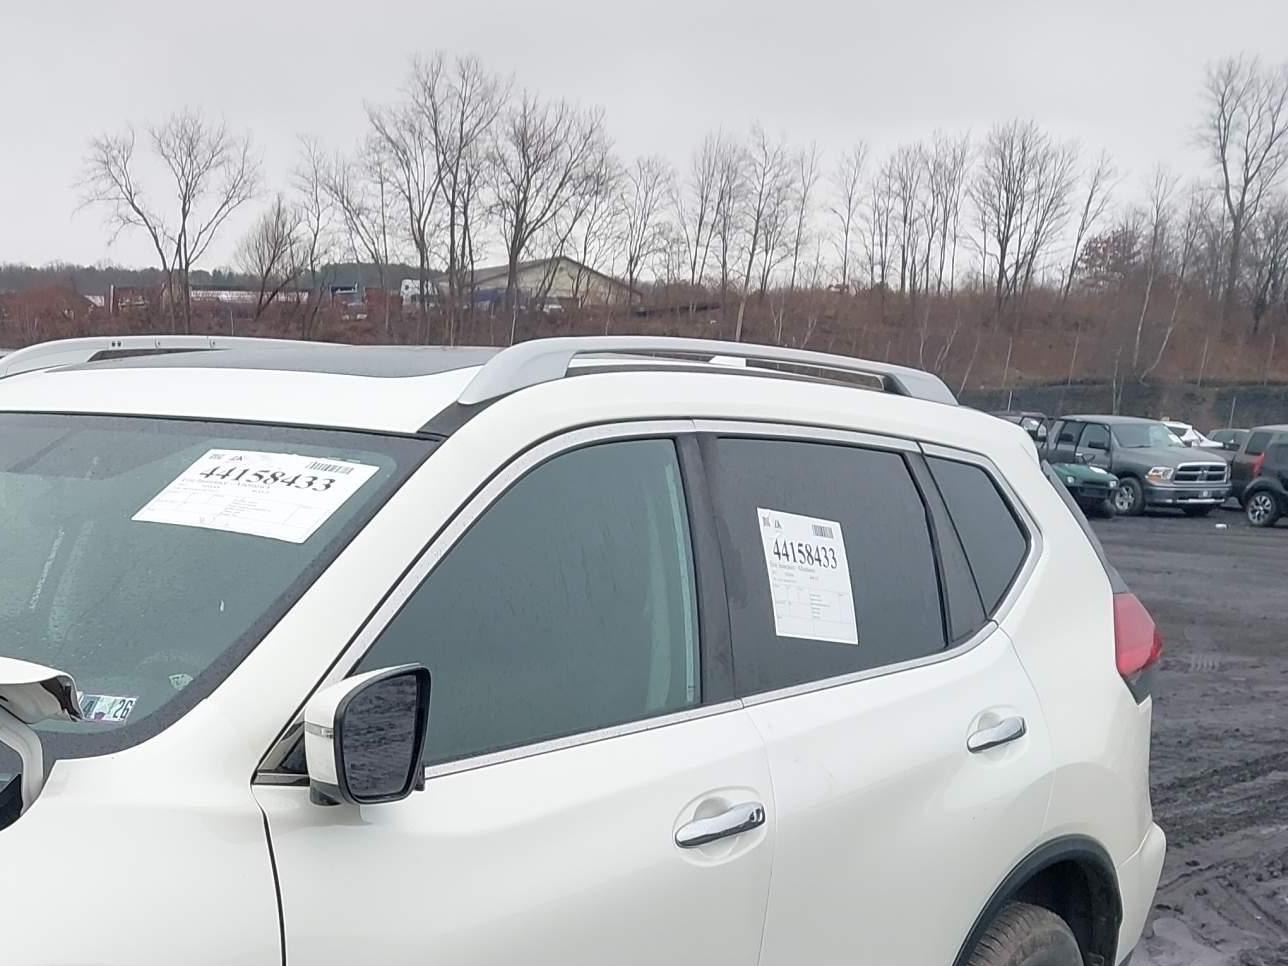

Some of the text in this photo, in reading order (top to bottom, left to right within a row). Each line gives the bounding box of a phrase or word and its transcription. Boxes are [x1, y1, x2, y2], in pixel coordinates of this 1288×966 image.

[200, 466, 335, 491] 44158433
[773, 537, 837, 569] 44158433
[113, 699, 133, 718] 26
